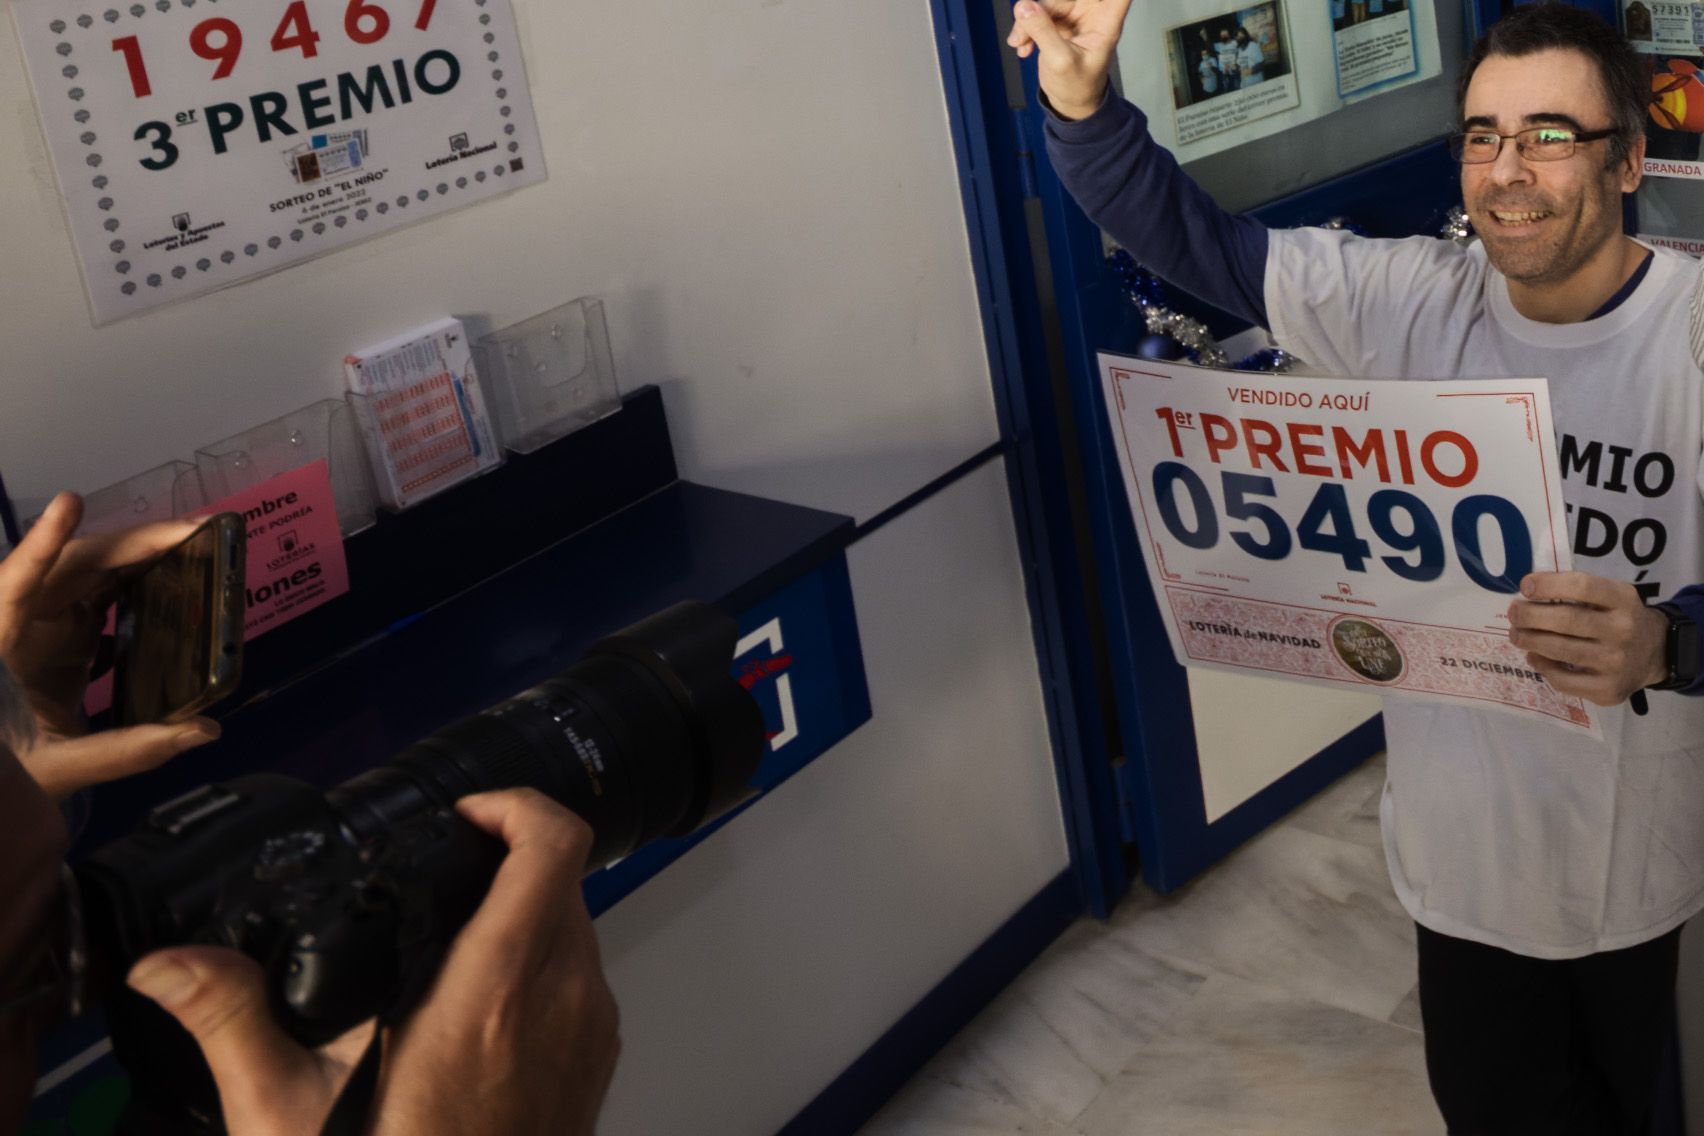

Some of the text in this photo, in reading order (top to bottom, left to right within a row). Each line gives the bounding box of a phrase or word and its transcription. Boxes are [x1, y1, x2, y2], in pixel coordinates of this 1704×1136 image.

[204, 48, 461, 155] PREMIO
[1644, 162, 1701, 176] GRANADA
[1227, 386, 1370, 412] VENDIDO AQUÍ
[1199, 411, 1479, 489] PREMIO
[1151, 459, 1534, 596] 05490
[1189, 620, 1242, 638] LOTERÍA
[1258, 630, 1321, 650] NAVIDAD
[1439, 656, 1544, 682] 22 DICIEMBRE
